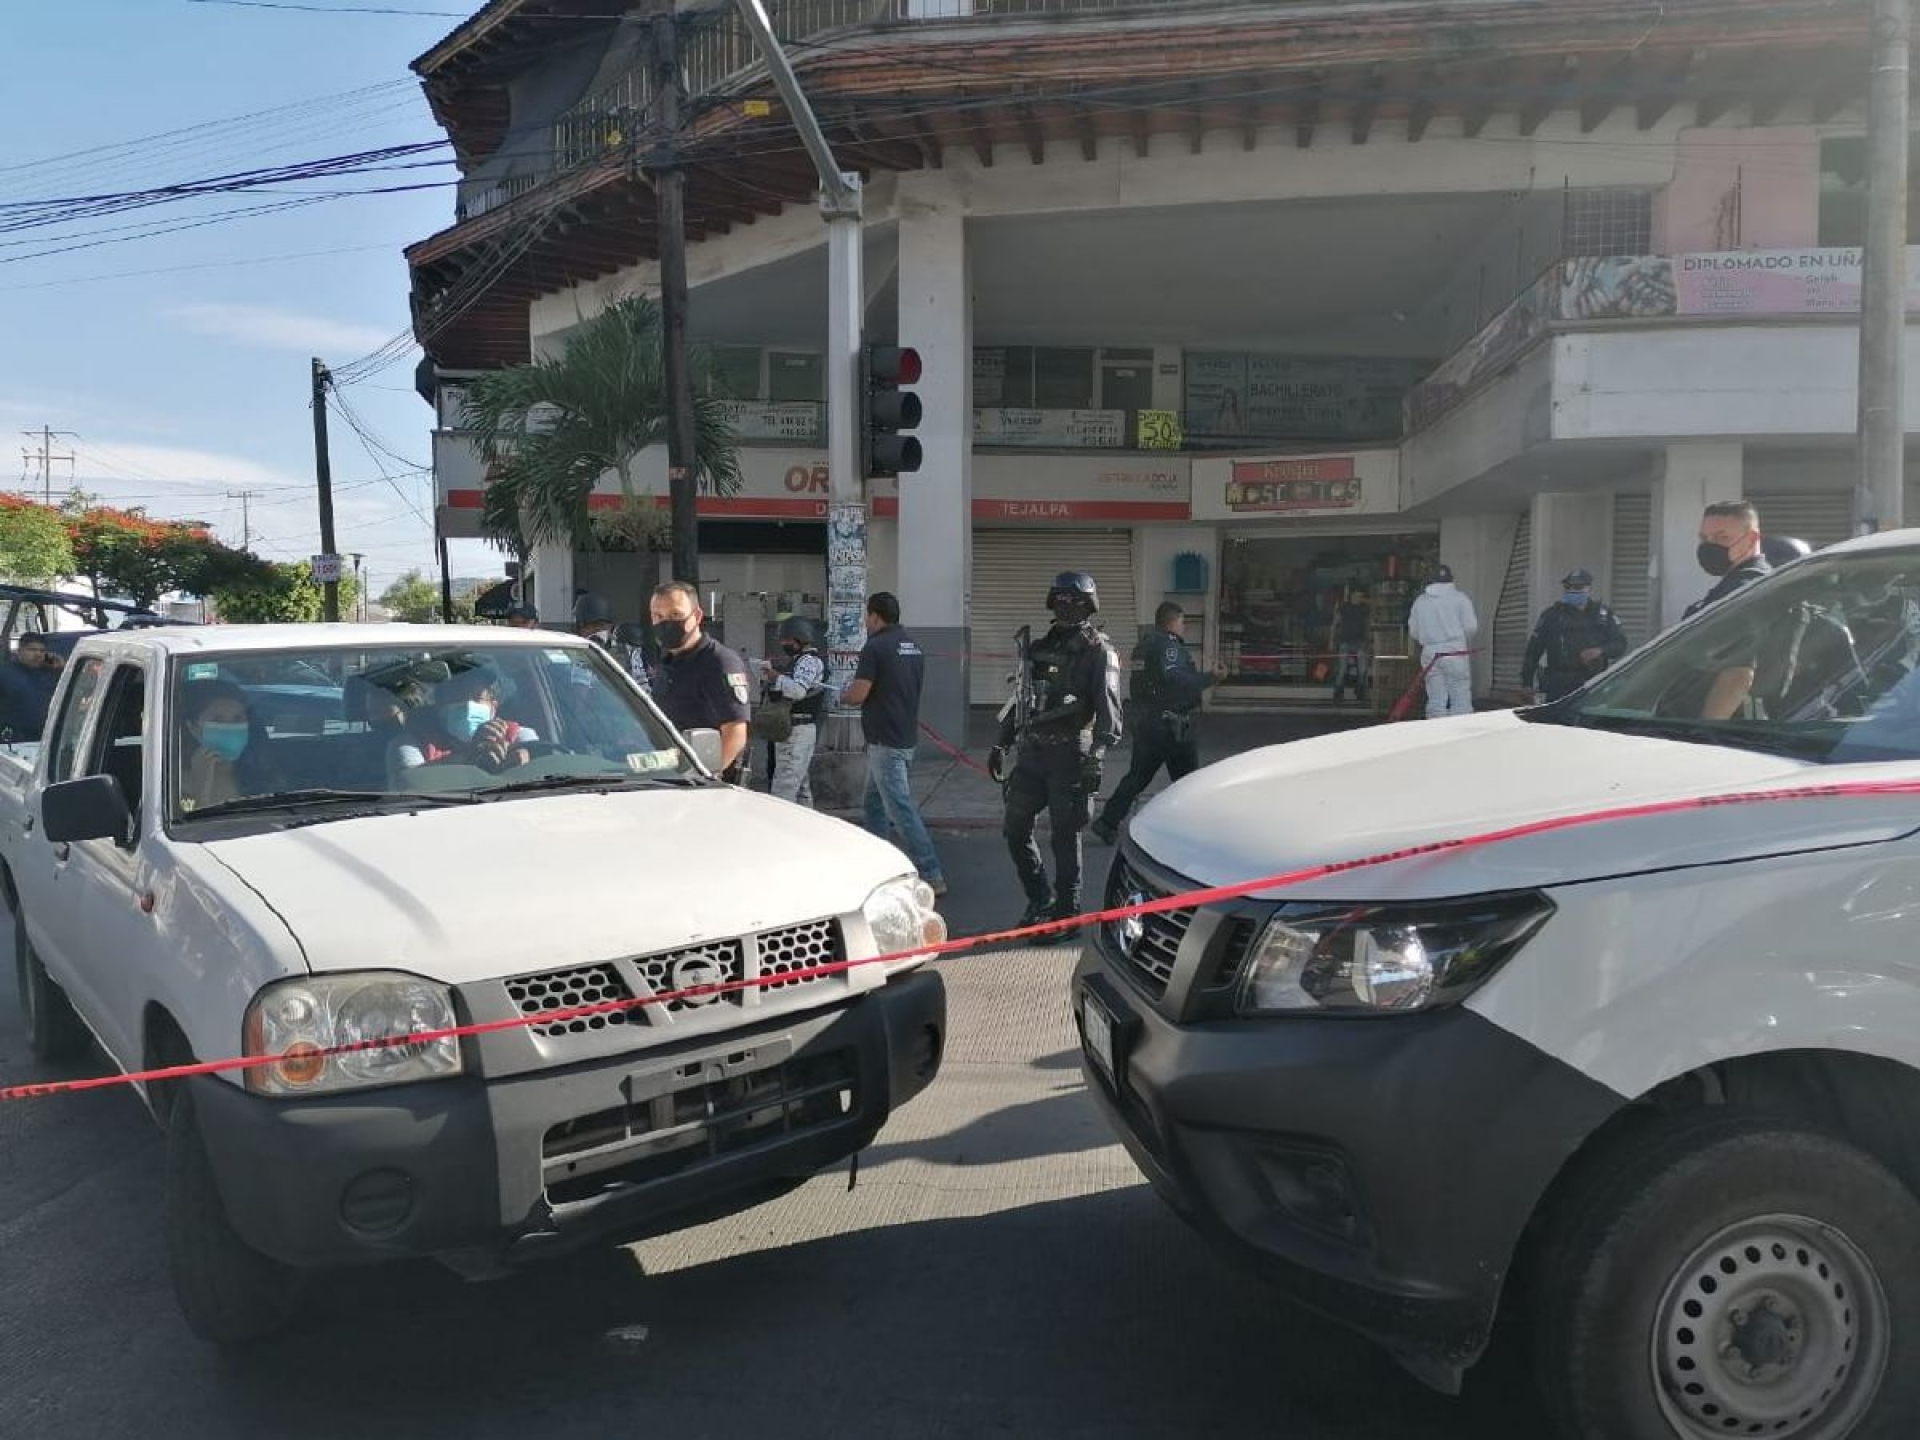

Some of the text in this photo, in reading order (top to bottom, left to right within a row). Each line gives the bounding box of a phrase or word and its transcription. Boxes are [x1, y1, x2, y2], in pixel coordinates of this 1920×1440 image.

[1684, 256, 1793, 271] DIPLOMADO
[1799, 256, 1823, 268] EN
[784, 466, 830, 492] OR
[1001, 503, 1069, 516] TEJALPA
